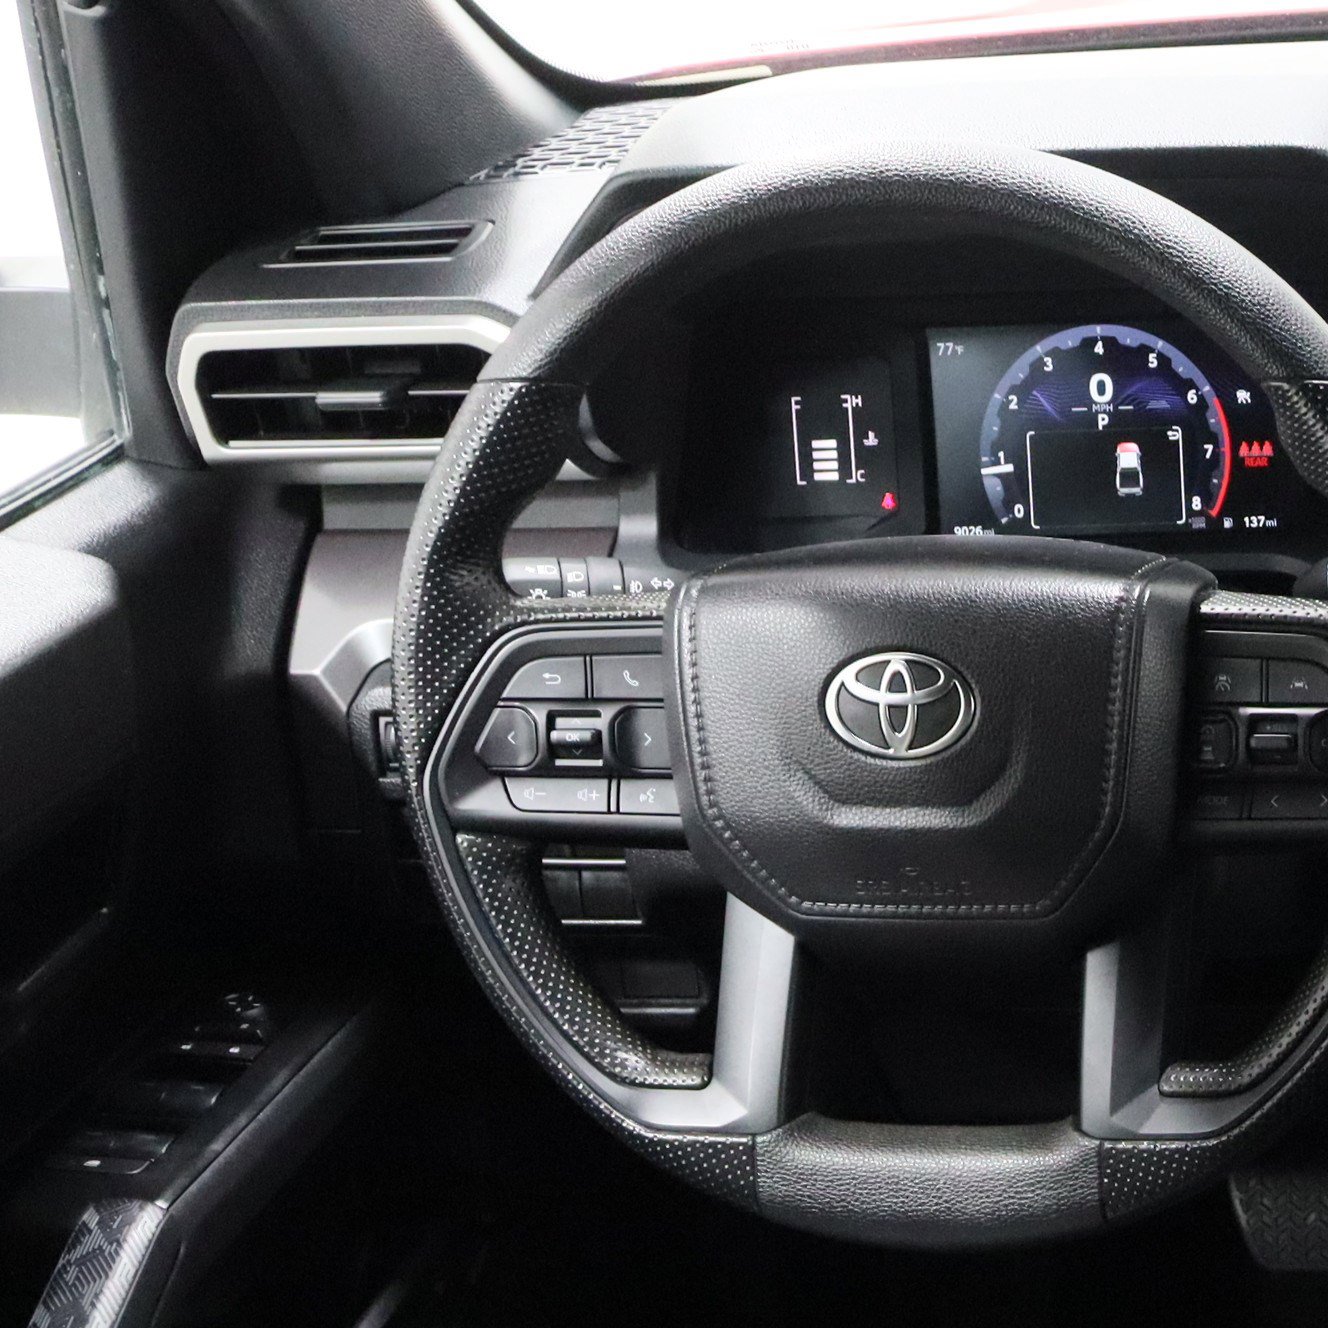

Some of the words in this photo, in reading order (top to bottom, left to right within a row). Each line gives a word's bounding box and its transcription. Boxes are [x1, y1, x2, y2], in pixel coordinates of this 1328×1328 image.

[1093, 340, 1105, 356] 4
[1043, 356, 1054, 372] 3
[1147, 352, 1158, 369] 5
[1088, 372, 1114, 403] 0
[851, 394, 863, 407] H
[1008, 395, 1019, 410] 2
[1186, 389, 1198, 404] 6
[1092, 403, 1114, 414] MPH
[1097, 414, 1109, 431] P
[998, 451, 1006, 464] 1
[1203, 443, 1214, 459] 7
[1244, 456, 1269, 467] REAR
[856, 469, 866, 482] C
[1013, 503, 1025, 518] 0
[1191, 496, 1203, 510] 8
[566, 733, 580, 742] OK
